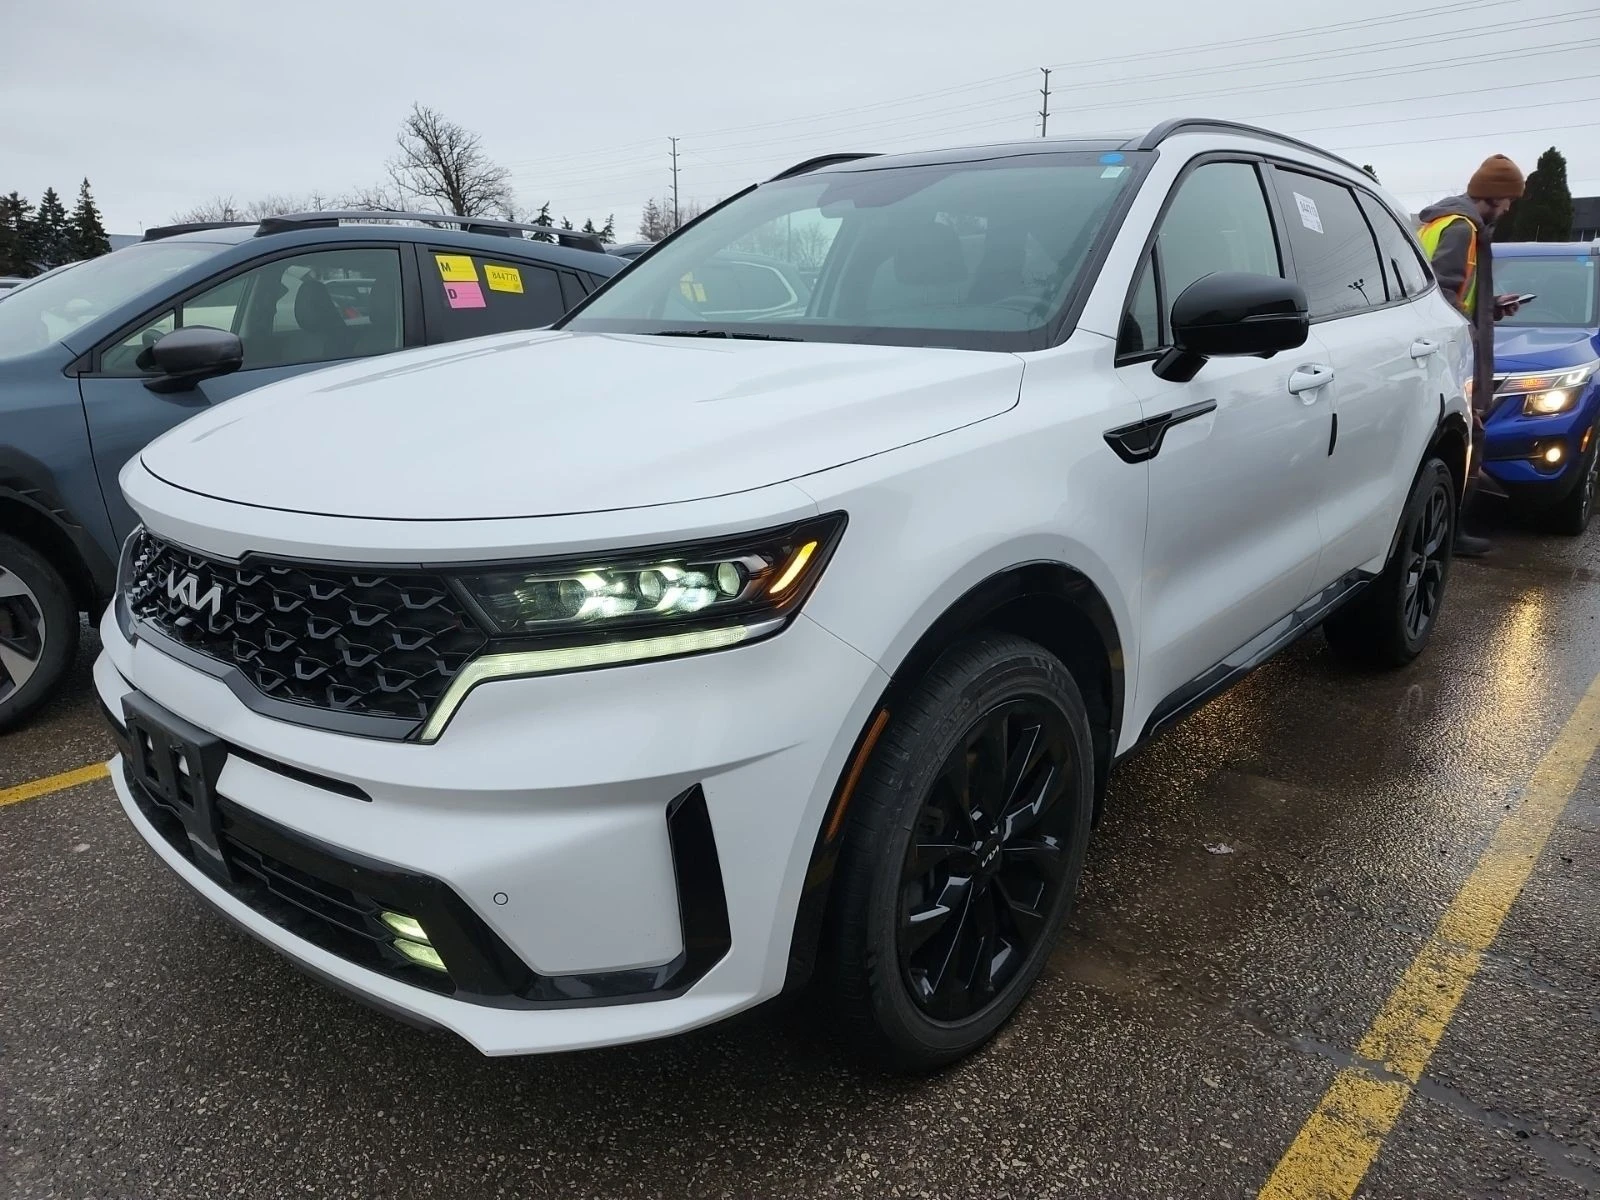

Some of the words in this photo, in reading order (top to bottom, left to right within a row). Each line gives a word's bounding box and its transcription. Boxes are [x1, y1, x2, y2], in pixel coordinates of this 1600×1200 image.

[440, 262, 451, 272] M
[447, 289, 458, 299] D
[167, 569, 222, 617] KIA
